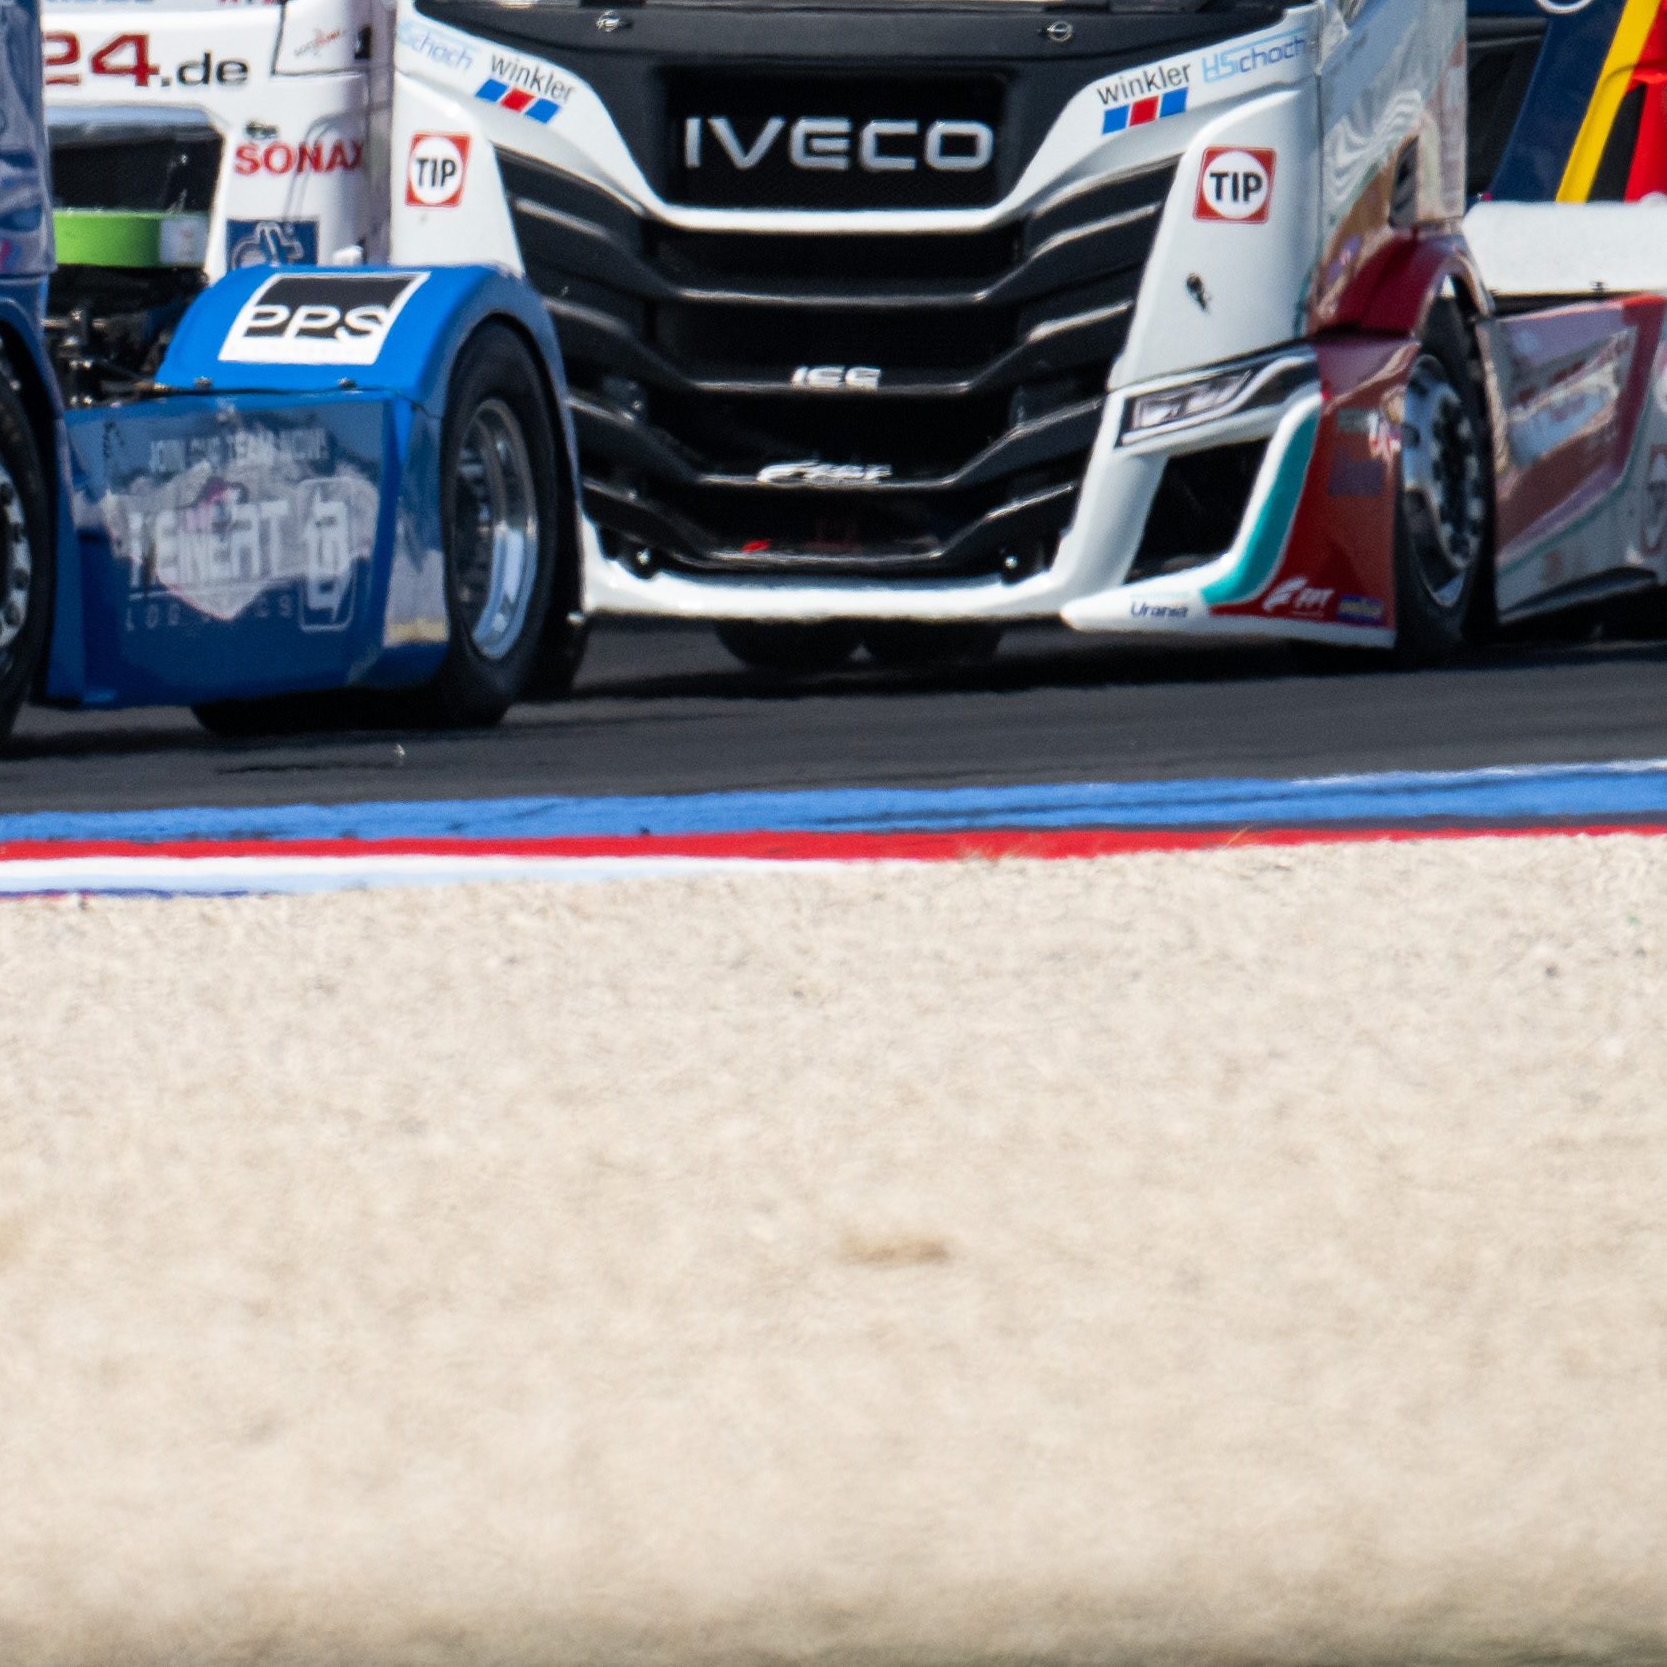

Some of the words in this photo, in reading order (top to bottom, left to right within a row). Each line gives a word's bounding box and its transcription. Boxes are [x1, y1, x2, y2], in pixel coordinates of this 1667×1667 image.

[490, 53, 575, 102] winkler
[1096, 63, 1192, 106] winkler
[683, 115, 995, 172] IVECO
[415, 157, 457, 189] TIP
[1209, 170, 1263, 203] TIP
[233, 302, 390, 343] PPS
